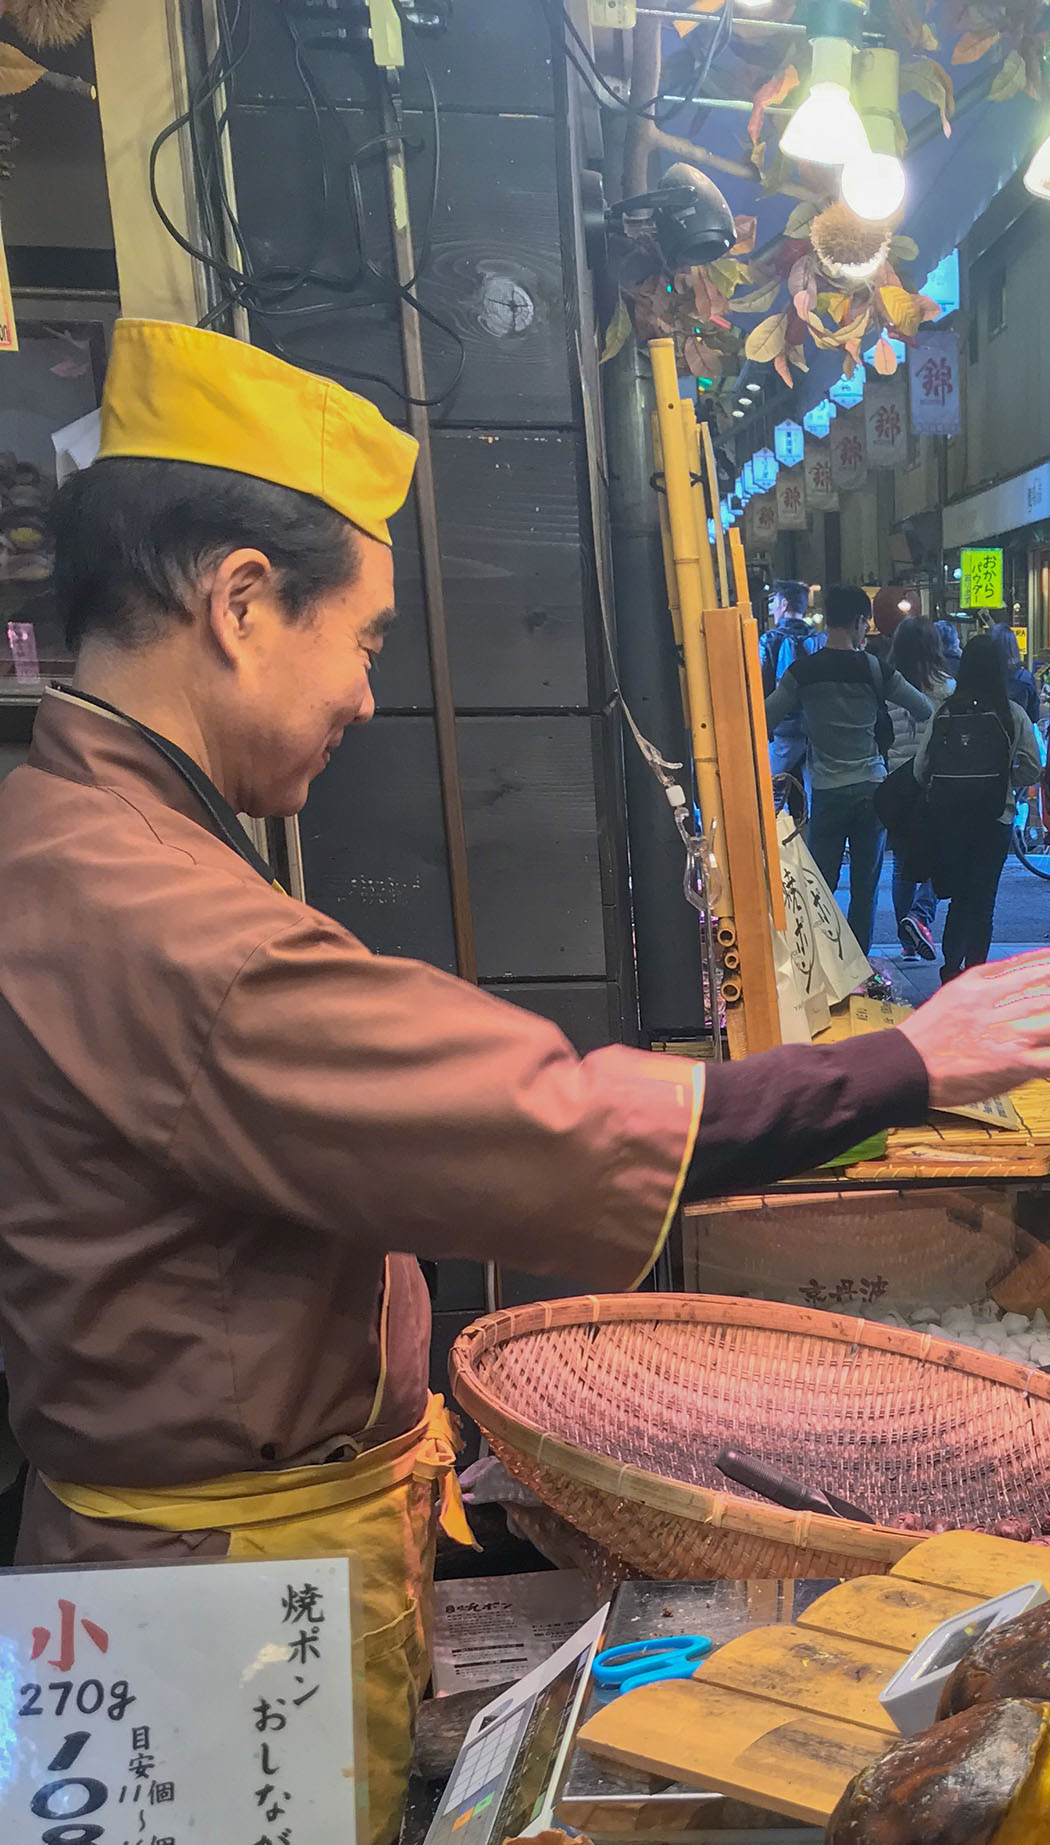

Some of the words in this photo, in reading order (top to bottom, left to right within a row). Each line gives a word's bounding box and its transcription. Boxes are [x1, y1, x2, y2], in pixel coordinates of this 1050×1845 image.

[916, 356, 953, 406] 錦
[972, 562, 983, 603] パウダー
[983, 555, 997, 599] おから
[798, 1275, 889, 1306] 京丹波
[31, 1598, 109, 1672] 小
[281, 1583, 326, 1706] 焼ポン
[18, 1678, 137, 1721] 270g
